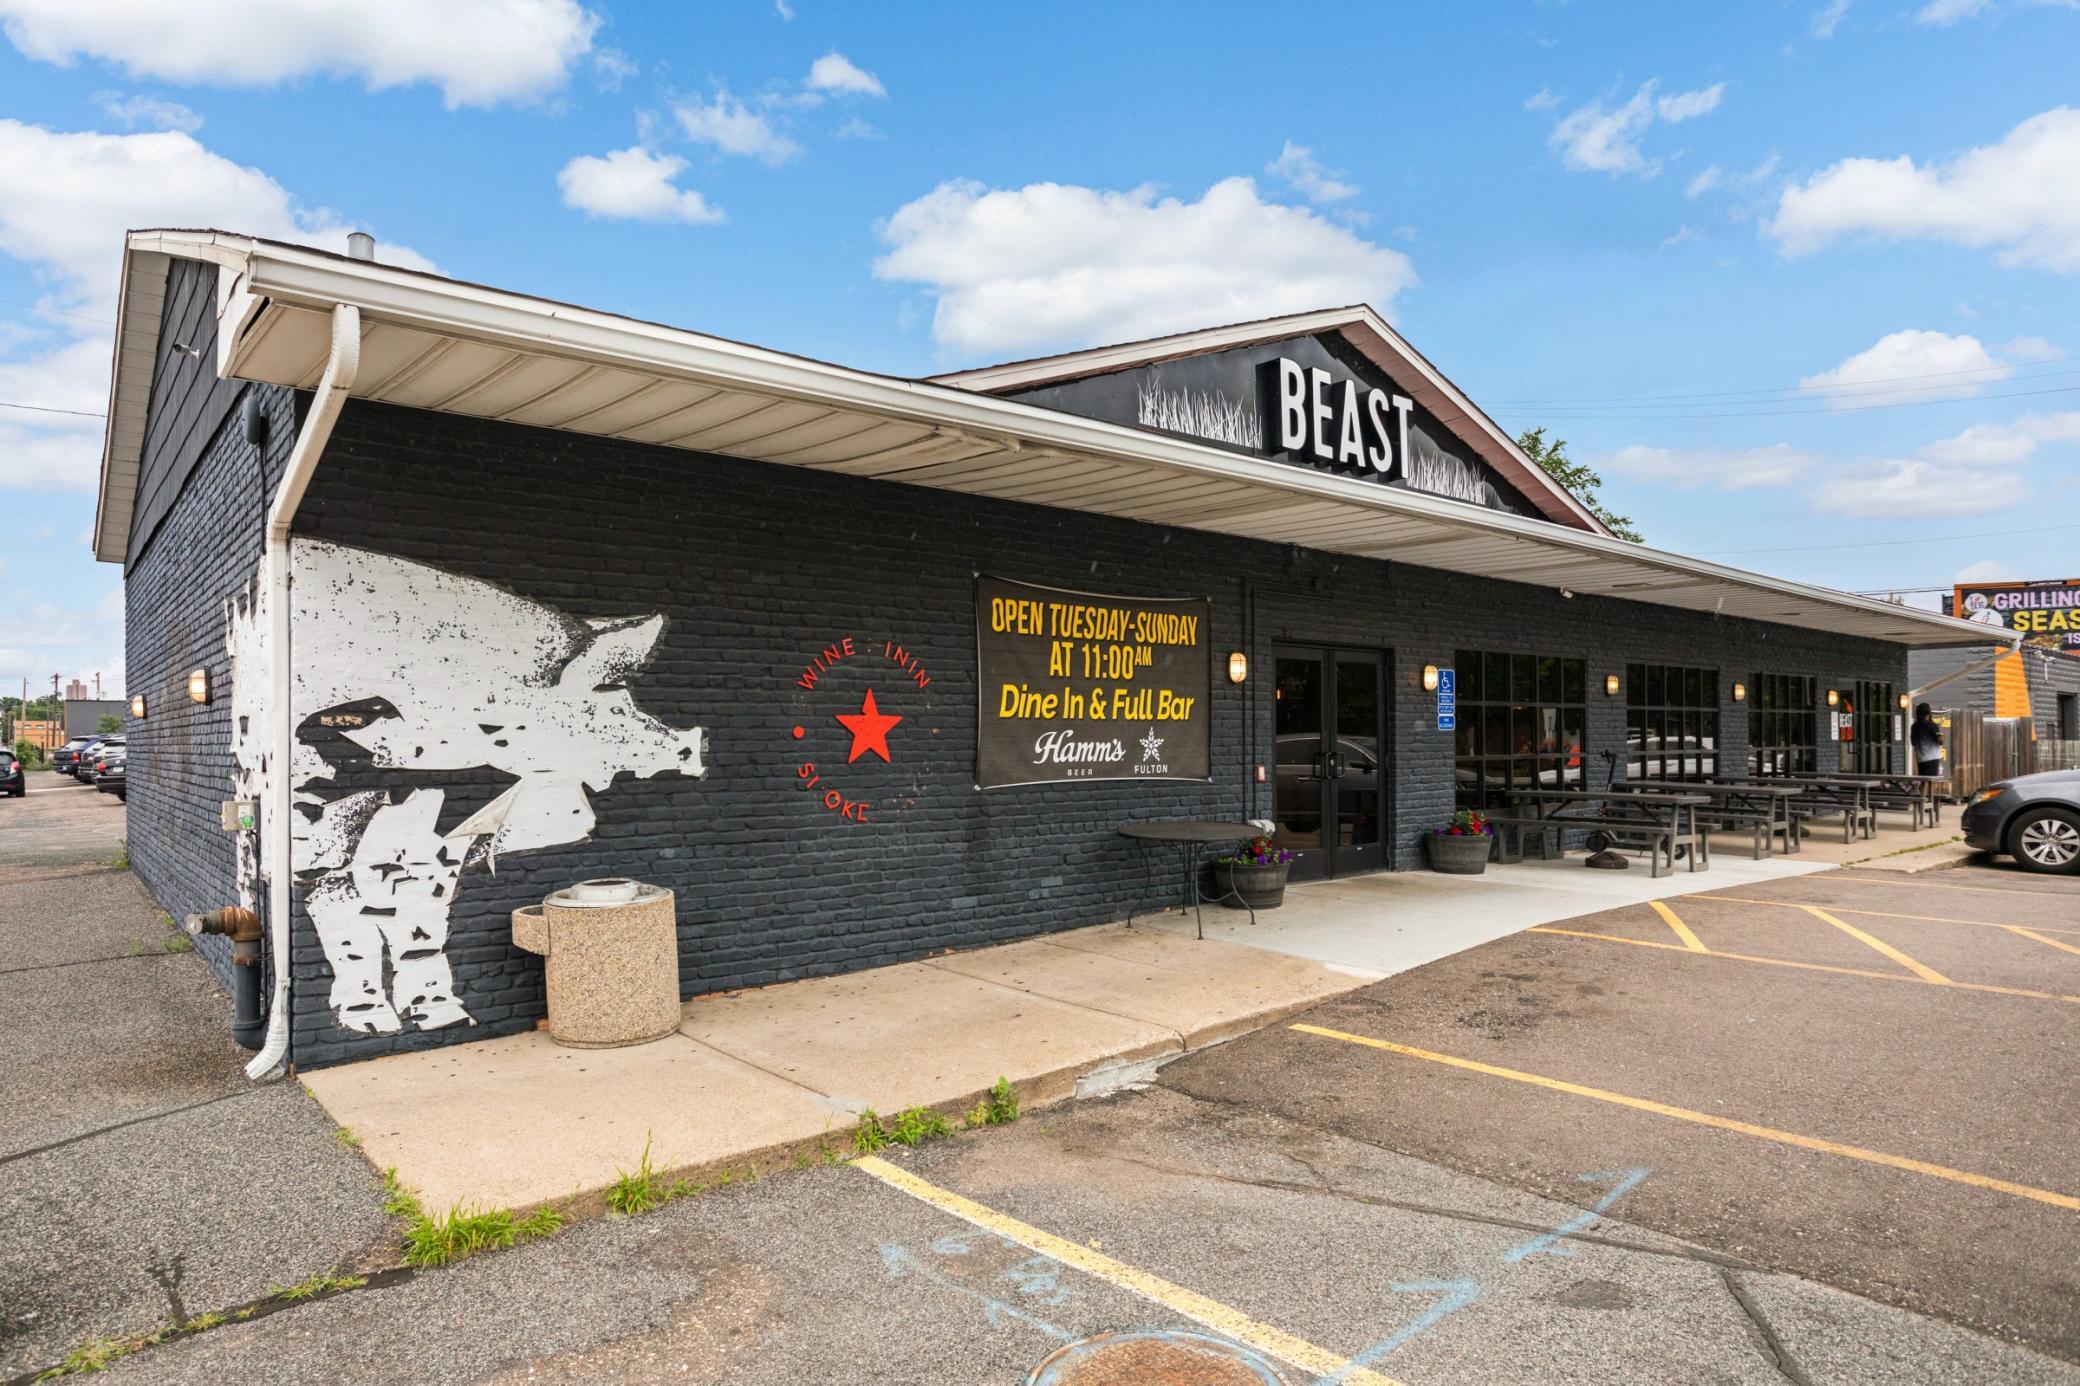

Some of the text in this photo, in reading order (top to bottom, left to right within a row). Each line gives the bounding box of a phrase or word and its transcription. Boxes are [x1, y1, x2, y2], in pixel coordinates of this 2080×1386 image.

[1279, 357, 1413, 479] BEAST
[991, 598, 1197, 645] OPEN TUESDAY-SUNDAY
[2013, 609, 2080, 632] SEAS
[797, 637, 855, 688] WINE
[1049, 640, 1074, 677] AT
[999, 684, 1194, 721] Dine In & Full Bar
[1033, 729, 1126, 764] Hamm's
[1067, 768, 1093, 776] BEER
[1134, 764, 1168, 775] FULTON
